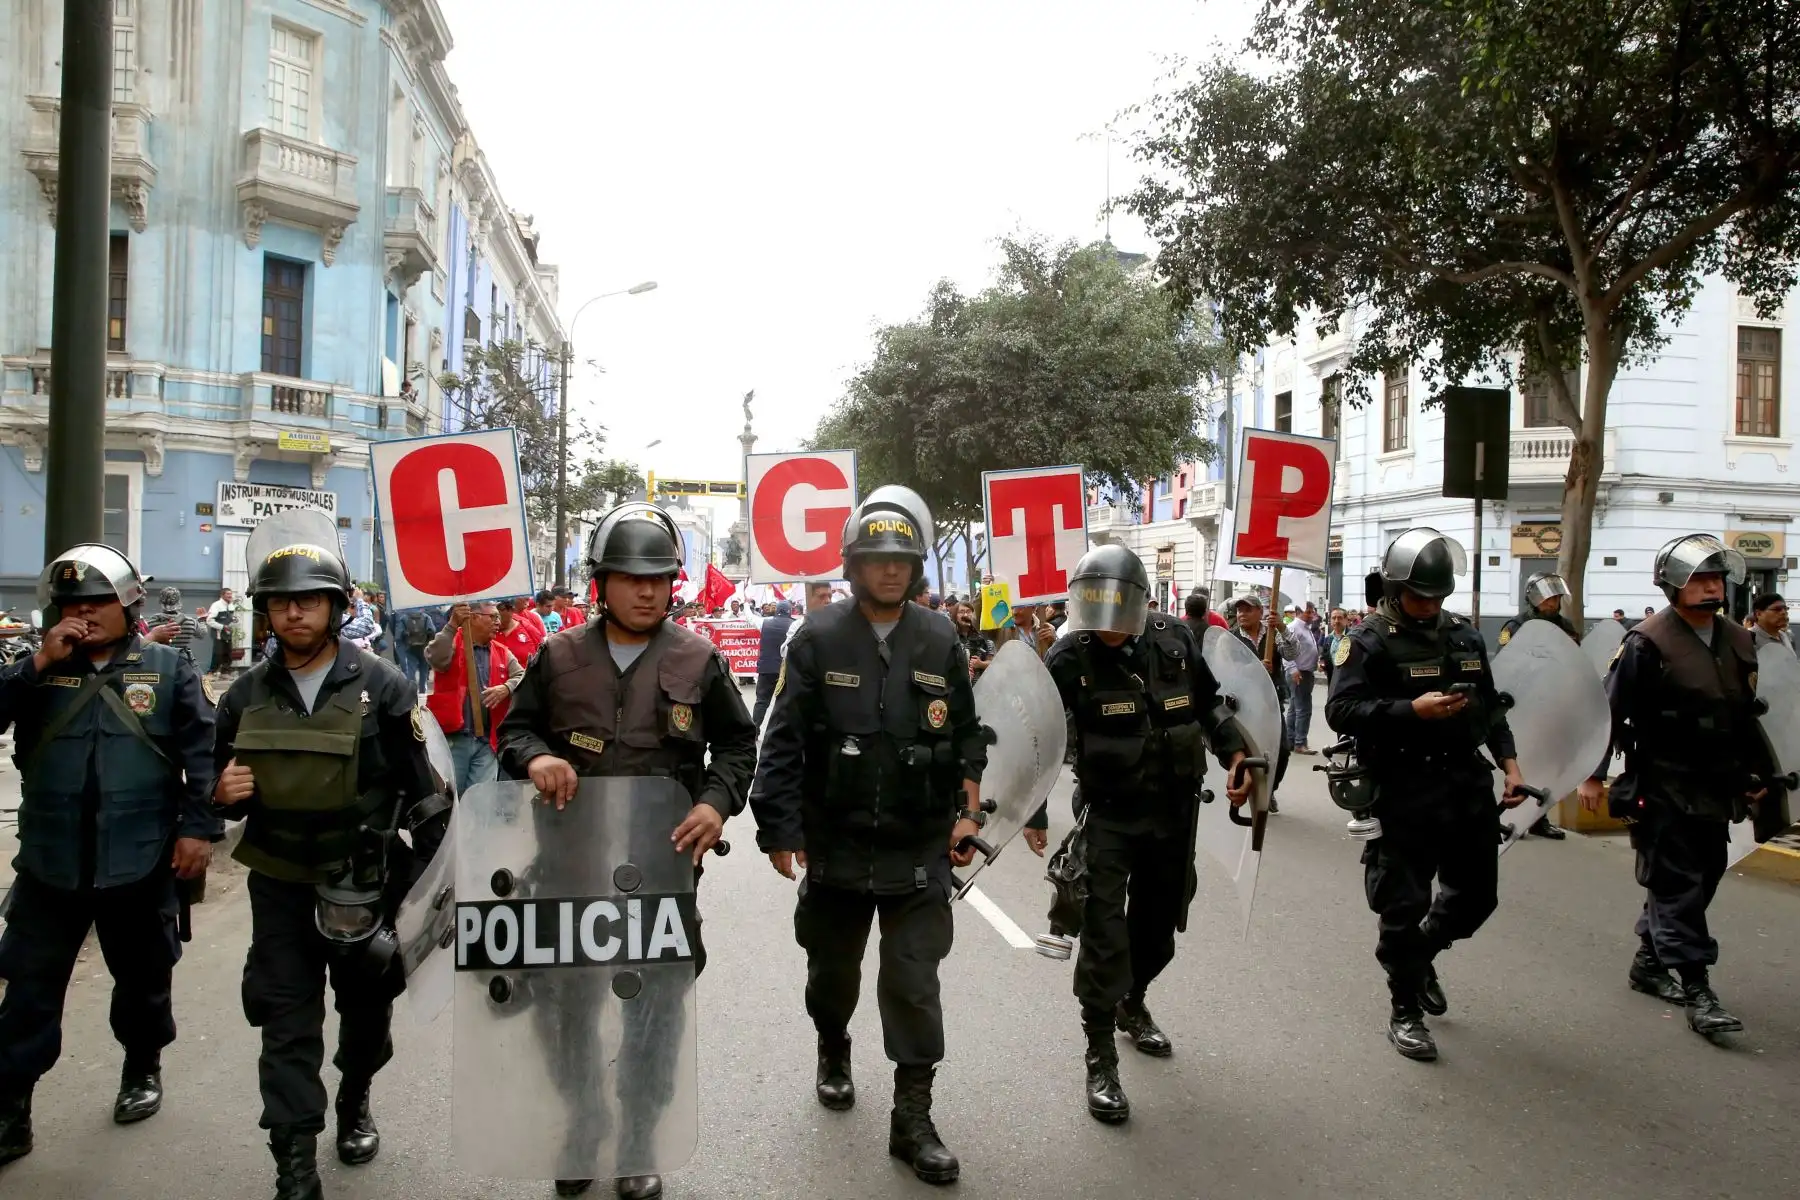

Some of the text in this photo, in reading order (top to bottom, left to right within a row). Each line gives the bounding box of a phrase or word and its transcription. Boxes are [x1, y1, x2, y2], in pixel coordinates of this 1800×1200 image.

[288, 489, 334, 512] MUSICALES
[390, 443, 513, 597] C
[752, 458, 852, 576] G
[869, 519, 913, 540] POLICIA
[1236, 437, 1331, 560] P
[267, 547, 320, 566] POLICIA
[990, 474, 1083, 598] T
[1739, 540, 1771, 548] EVANS
[458, 898, 692, 966] POLICIA
